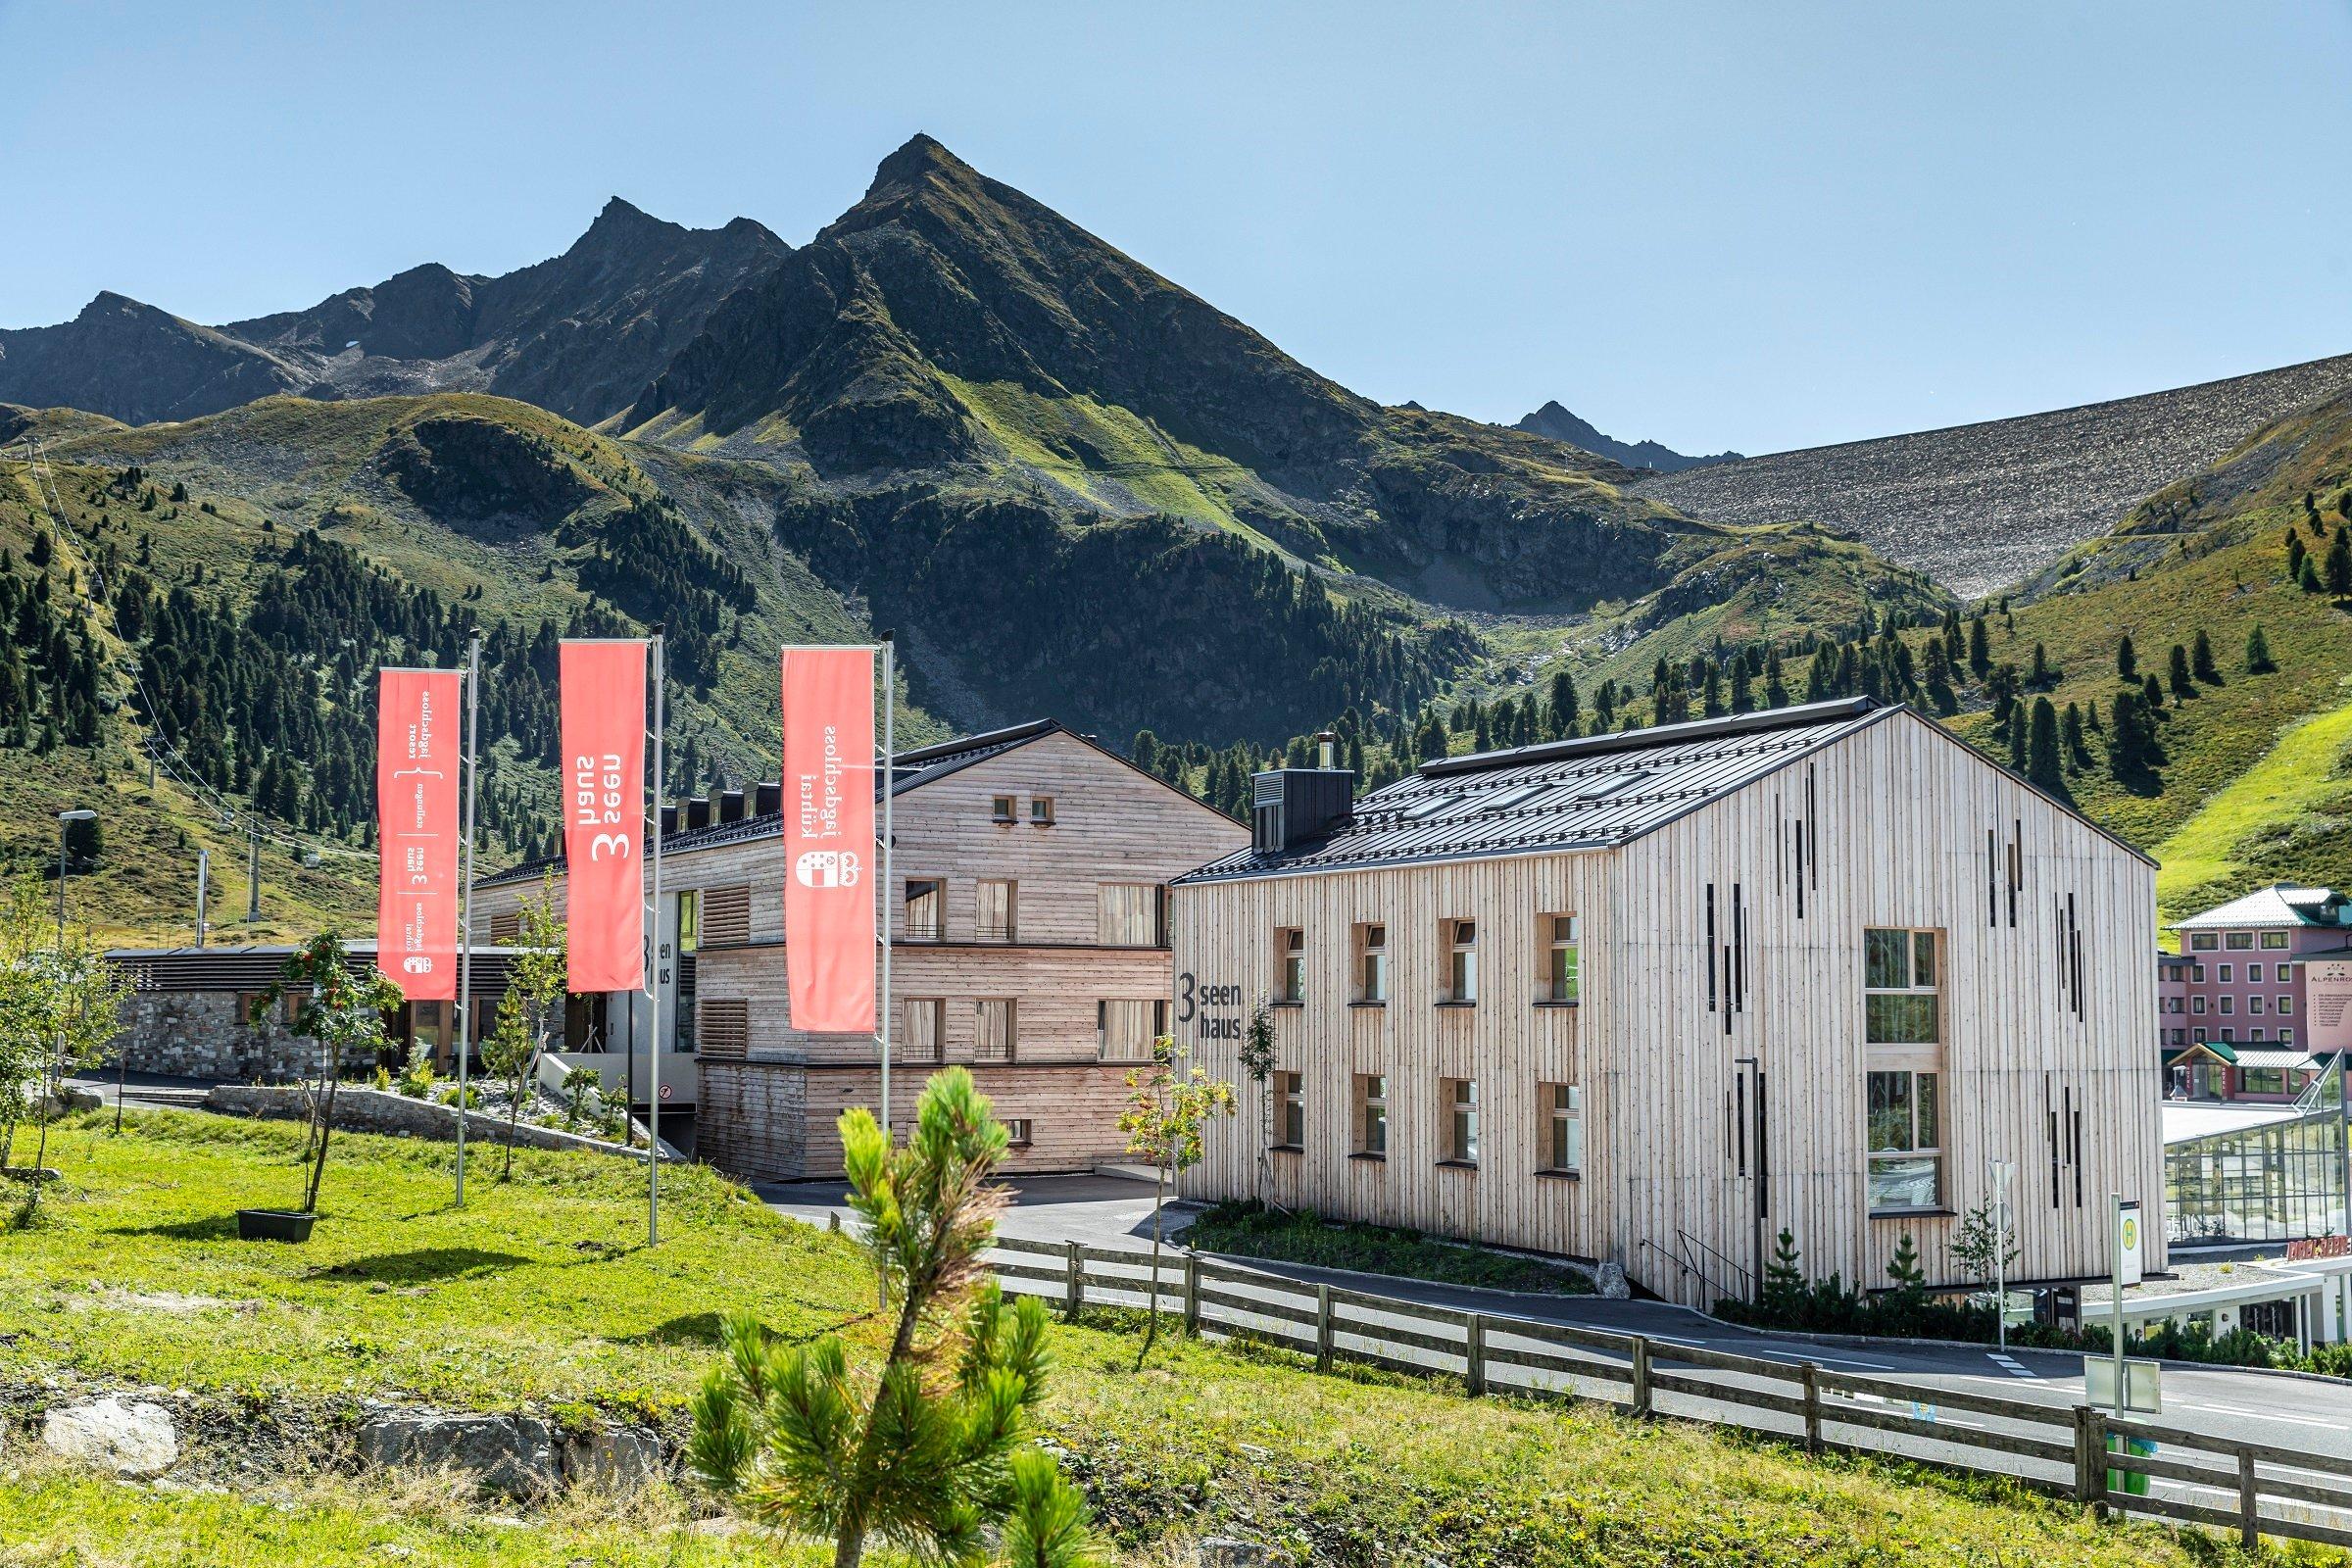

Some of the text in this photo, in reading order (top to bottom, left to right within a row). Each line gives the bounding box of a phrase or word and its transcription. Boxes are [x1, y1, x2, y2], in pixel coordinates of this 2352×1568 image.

[1178, 972, 1242, 1023] 3 seen
[1200, 1010, 1242, 1039] haus
